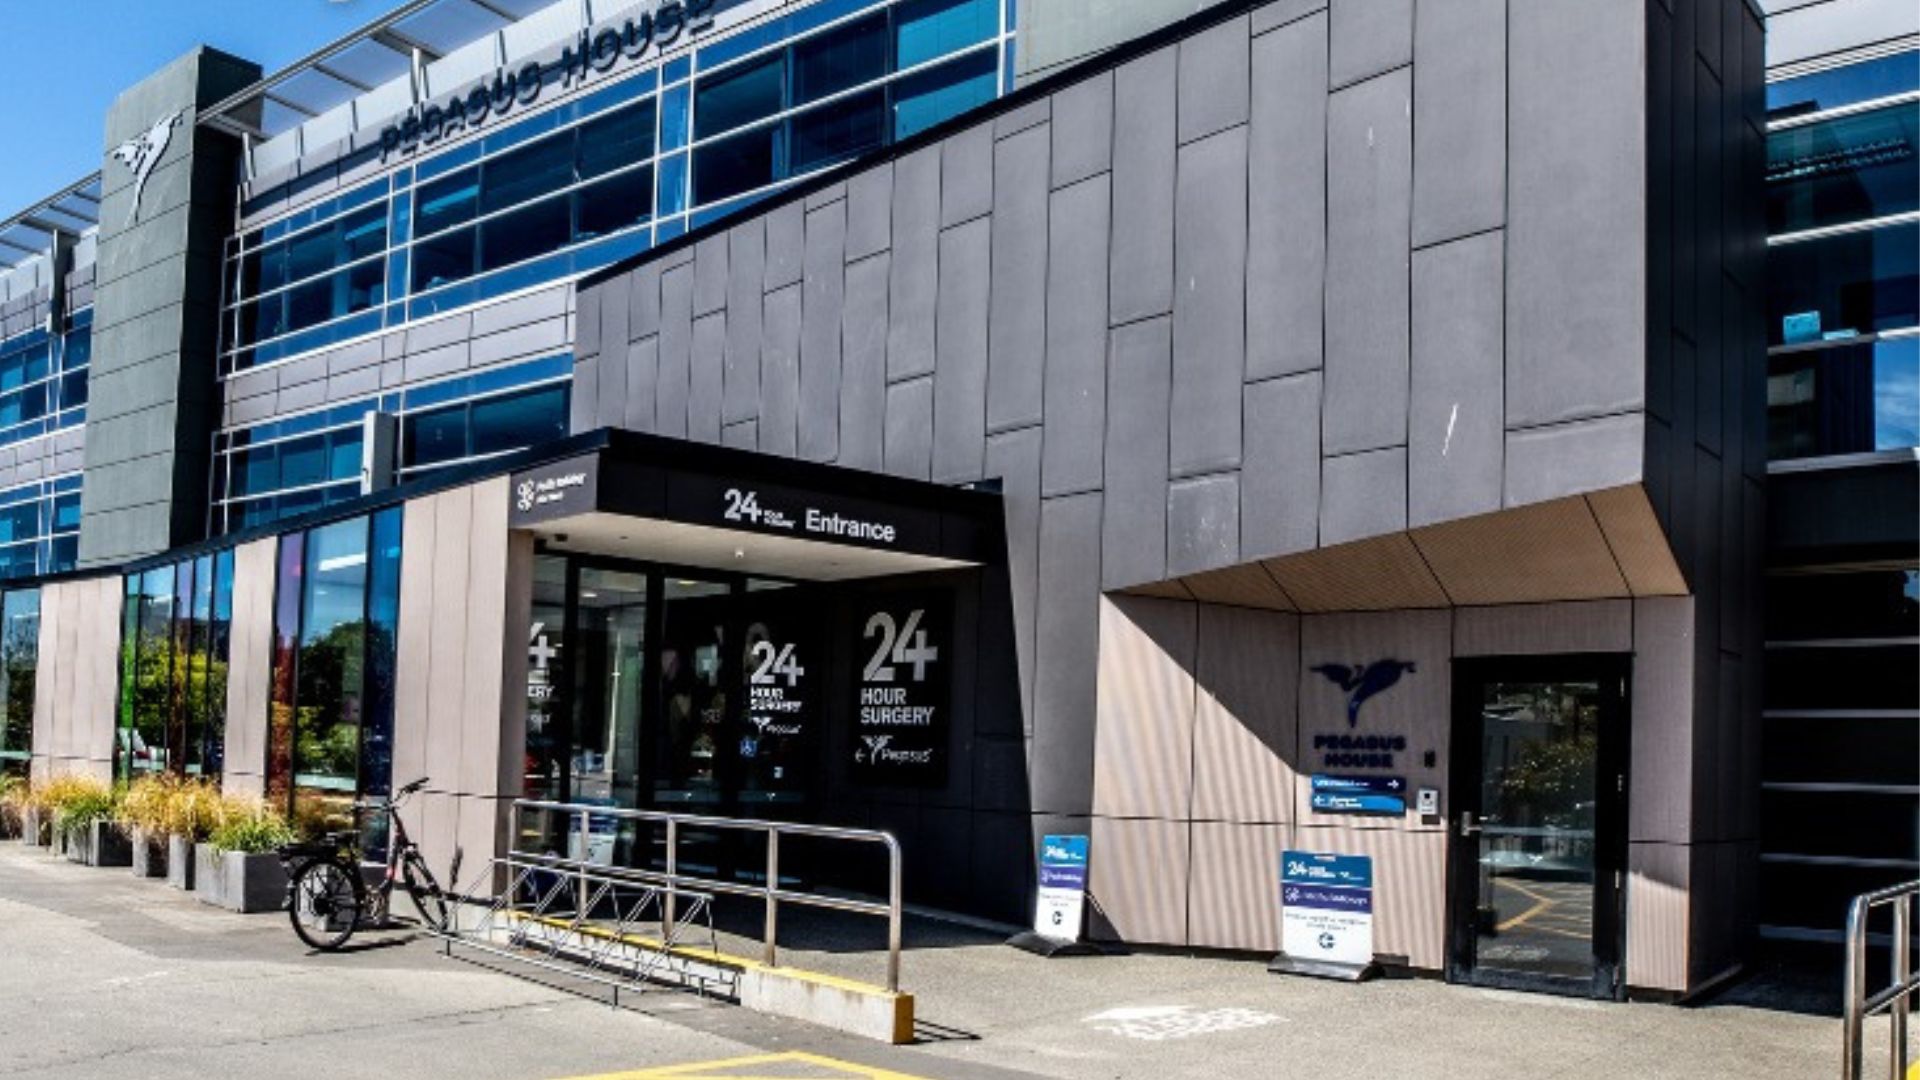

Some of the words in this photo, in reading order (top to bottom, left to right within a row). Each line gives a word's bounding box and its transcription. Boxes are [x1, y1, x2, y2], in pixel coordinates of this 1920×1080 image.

[379, 61, 542, 164] PEGASUS
[561, 0, 716, 89] HOUSE
[724, 488, 762, 523] 24
[805, 507, 896, 542] Entrance
[862, 609, 938, 681] 24
[750, 641, 804, 687] 24
[860, 688, 907, 705] HOUR
[860, 706, 935, 726] SURGERY
[1313, 735, 1406, 751] PEGASUS
[1324, 753, 1394, 768] HOUSE
